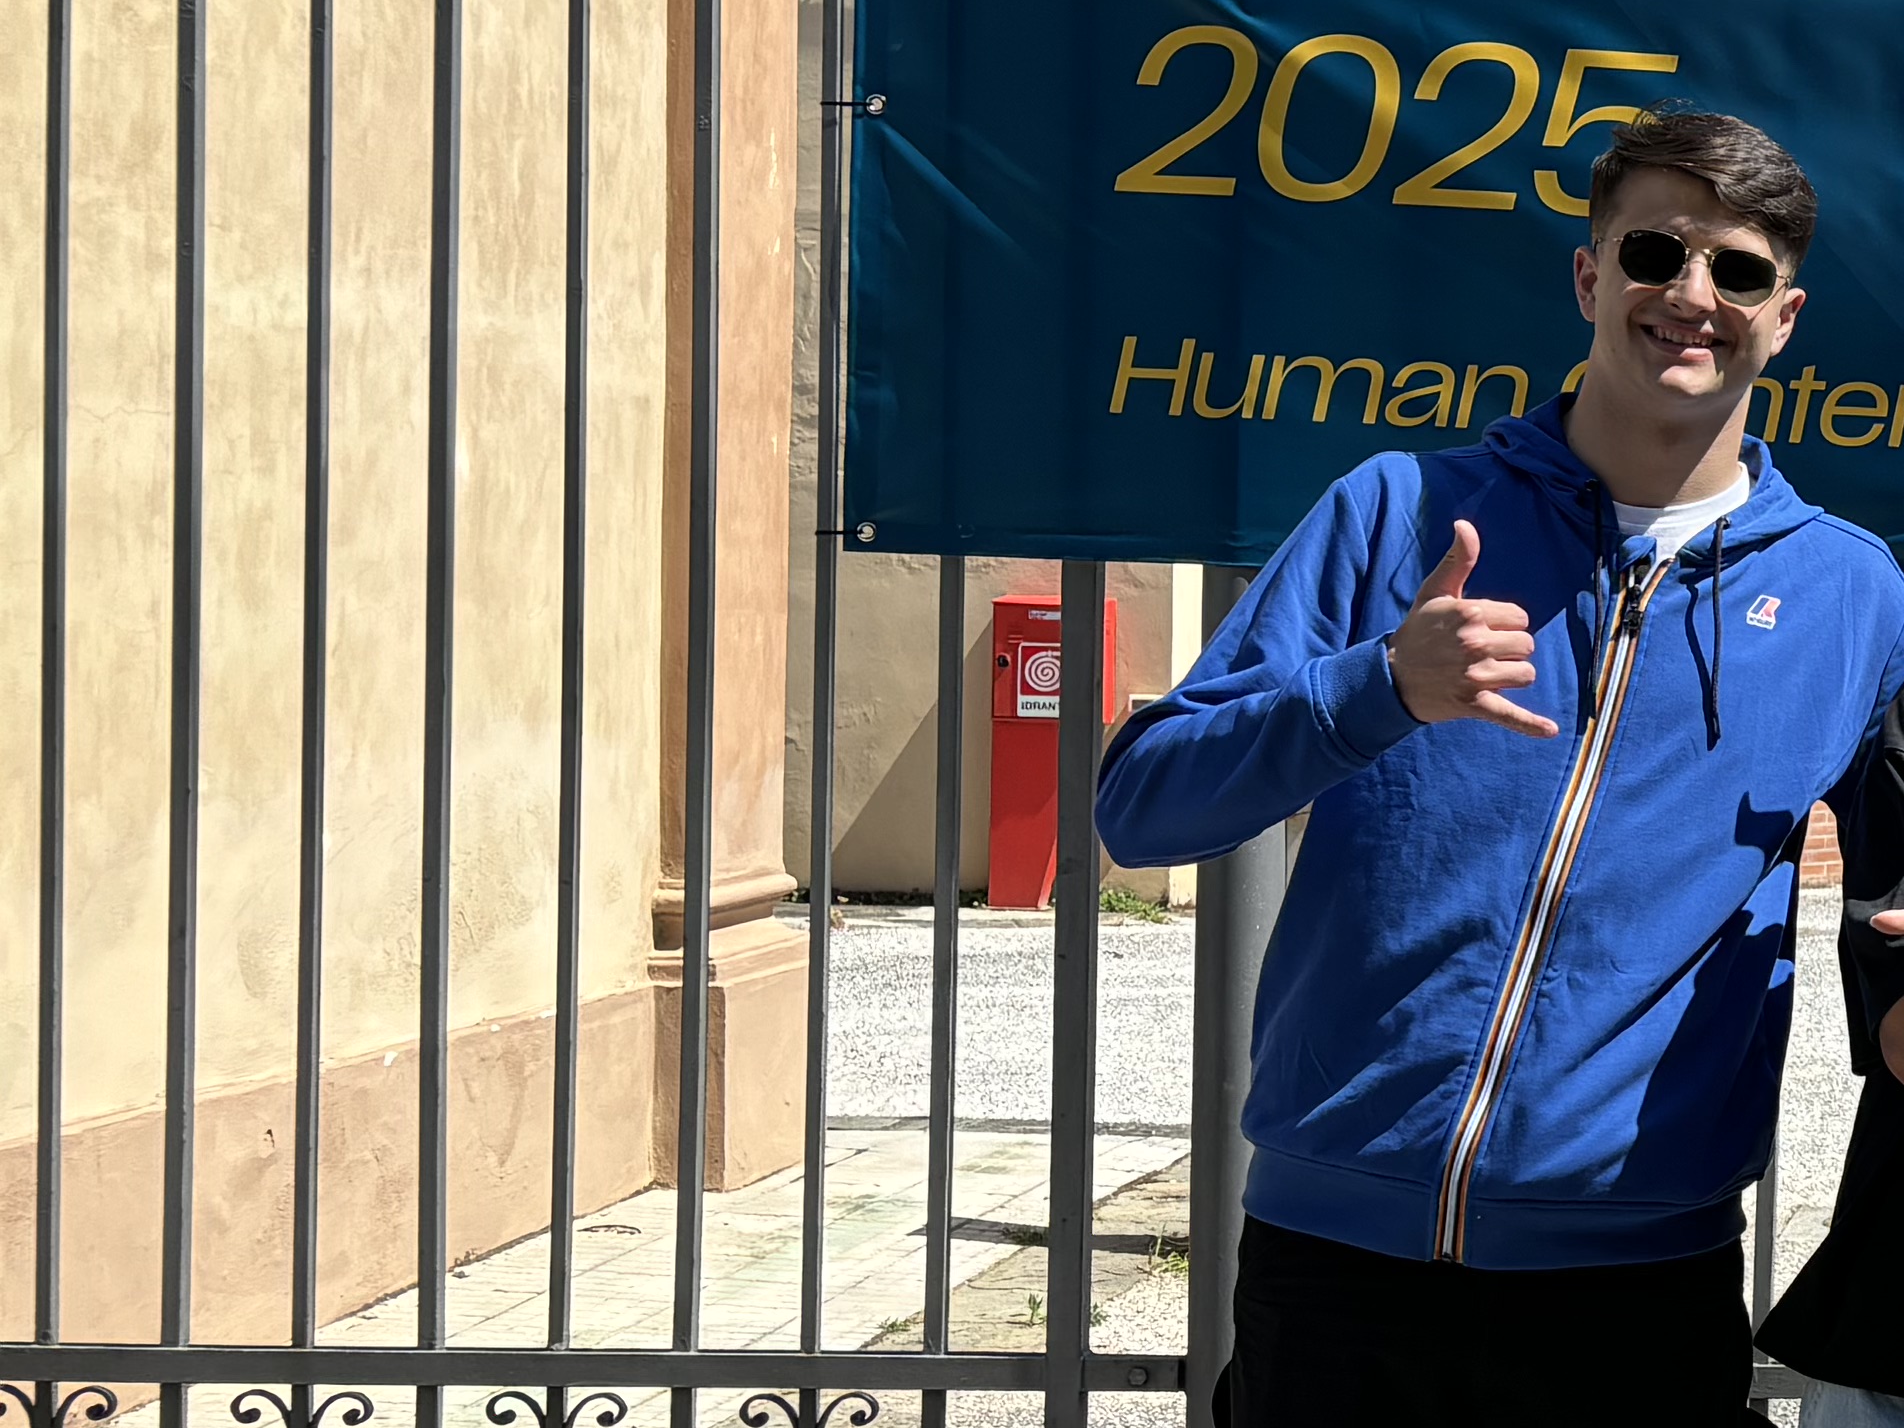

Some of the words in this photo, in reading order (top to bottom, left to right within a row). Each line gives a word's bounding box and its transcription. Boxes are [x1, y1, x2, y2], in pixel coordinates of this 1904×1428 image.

[1116, 25, 1680, 218] 2025
[1111, 337, 1529, 429] Human
[1020, 700, 1060, 712] IDRAN
